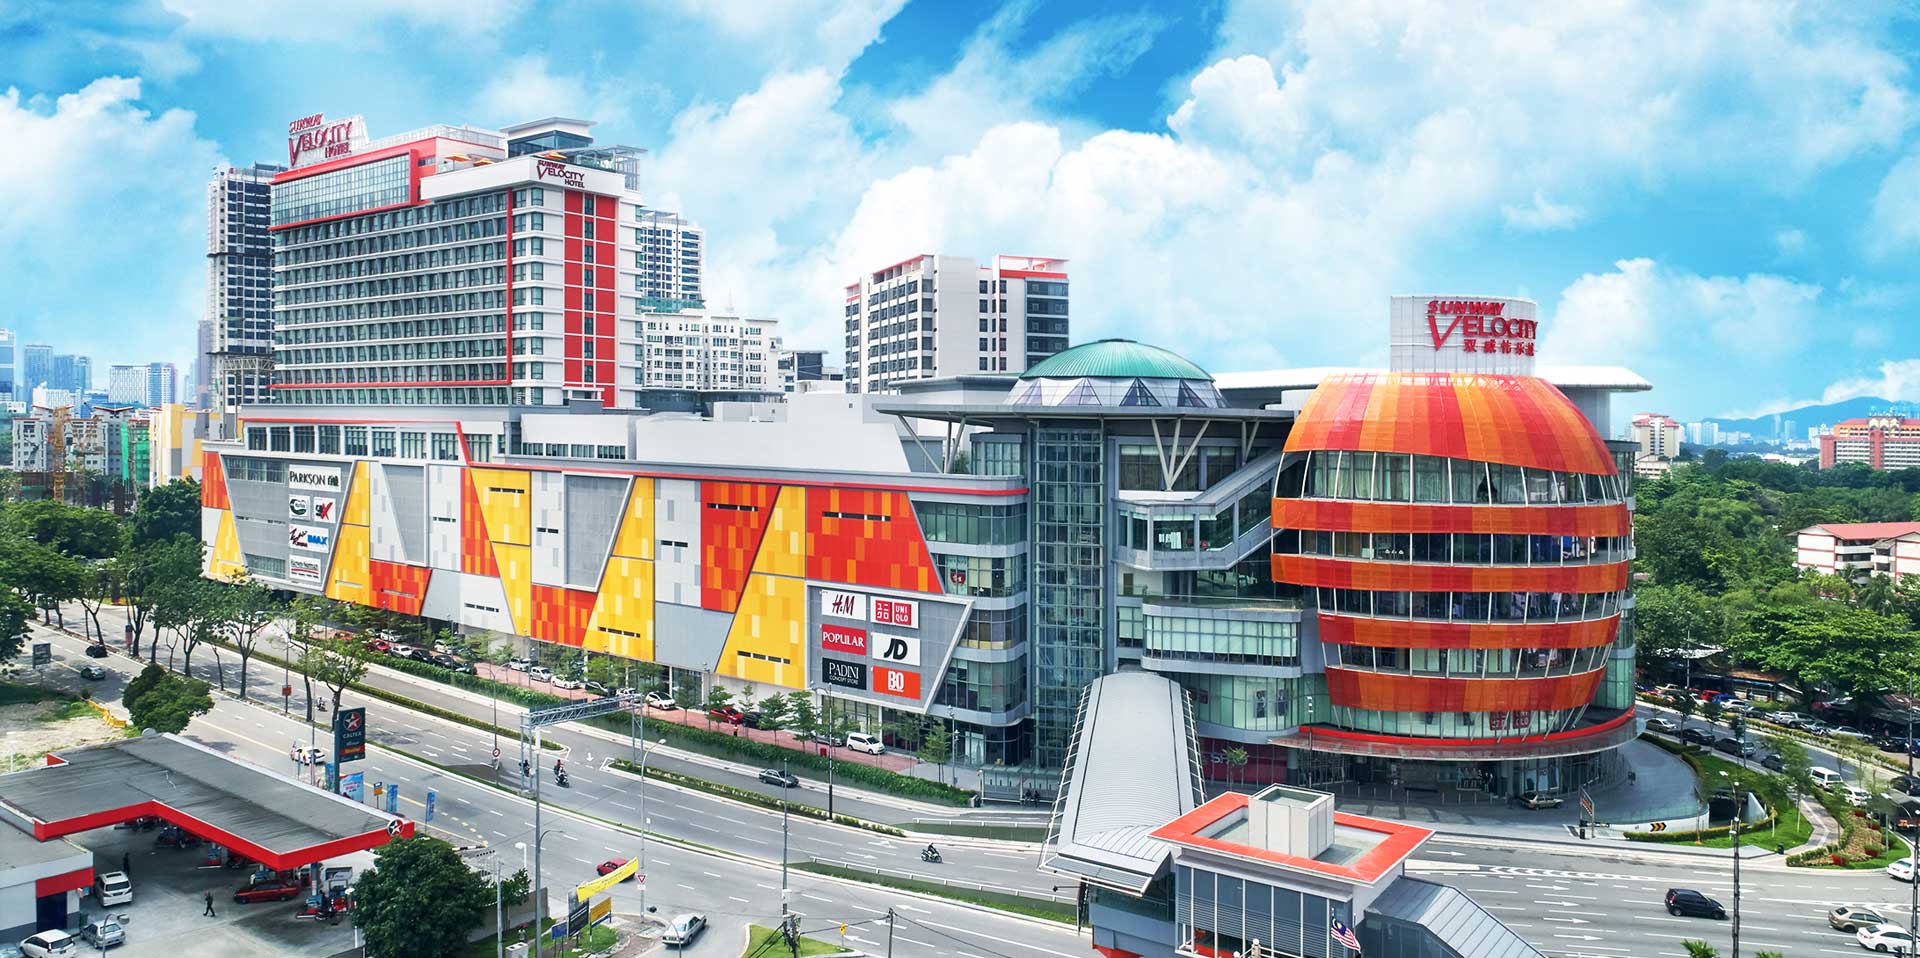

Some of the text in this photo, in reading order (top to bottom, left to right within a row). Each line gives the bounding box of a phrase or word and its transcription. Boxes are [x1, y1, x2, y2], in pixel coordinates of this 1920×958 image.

[288, 121, 352, 166] VELOCITY
[325, 142, 352, 158] HOTEL
[537, 160, 566, 169] SUNWAY
[536, 165, 584, 181] VELOCITY
[564, 179, 585, 188] HOTEL
[1427, 300, 1505, 315] SUNWAY
[1427, 315, 1538, 351] VELOCITY
[290, 470, 326, 485] PARKSON
[307, 534, 328, 545] IMAX
[832, 593, 856, 616] H&M
[822, 631, 865, 648] POPULAR
[884, 638, 908, 660] JD
[829, 662, 859, 679] PADINI
